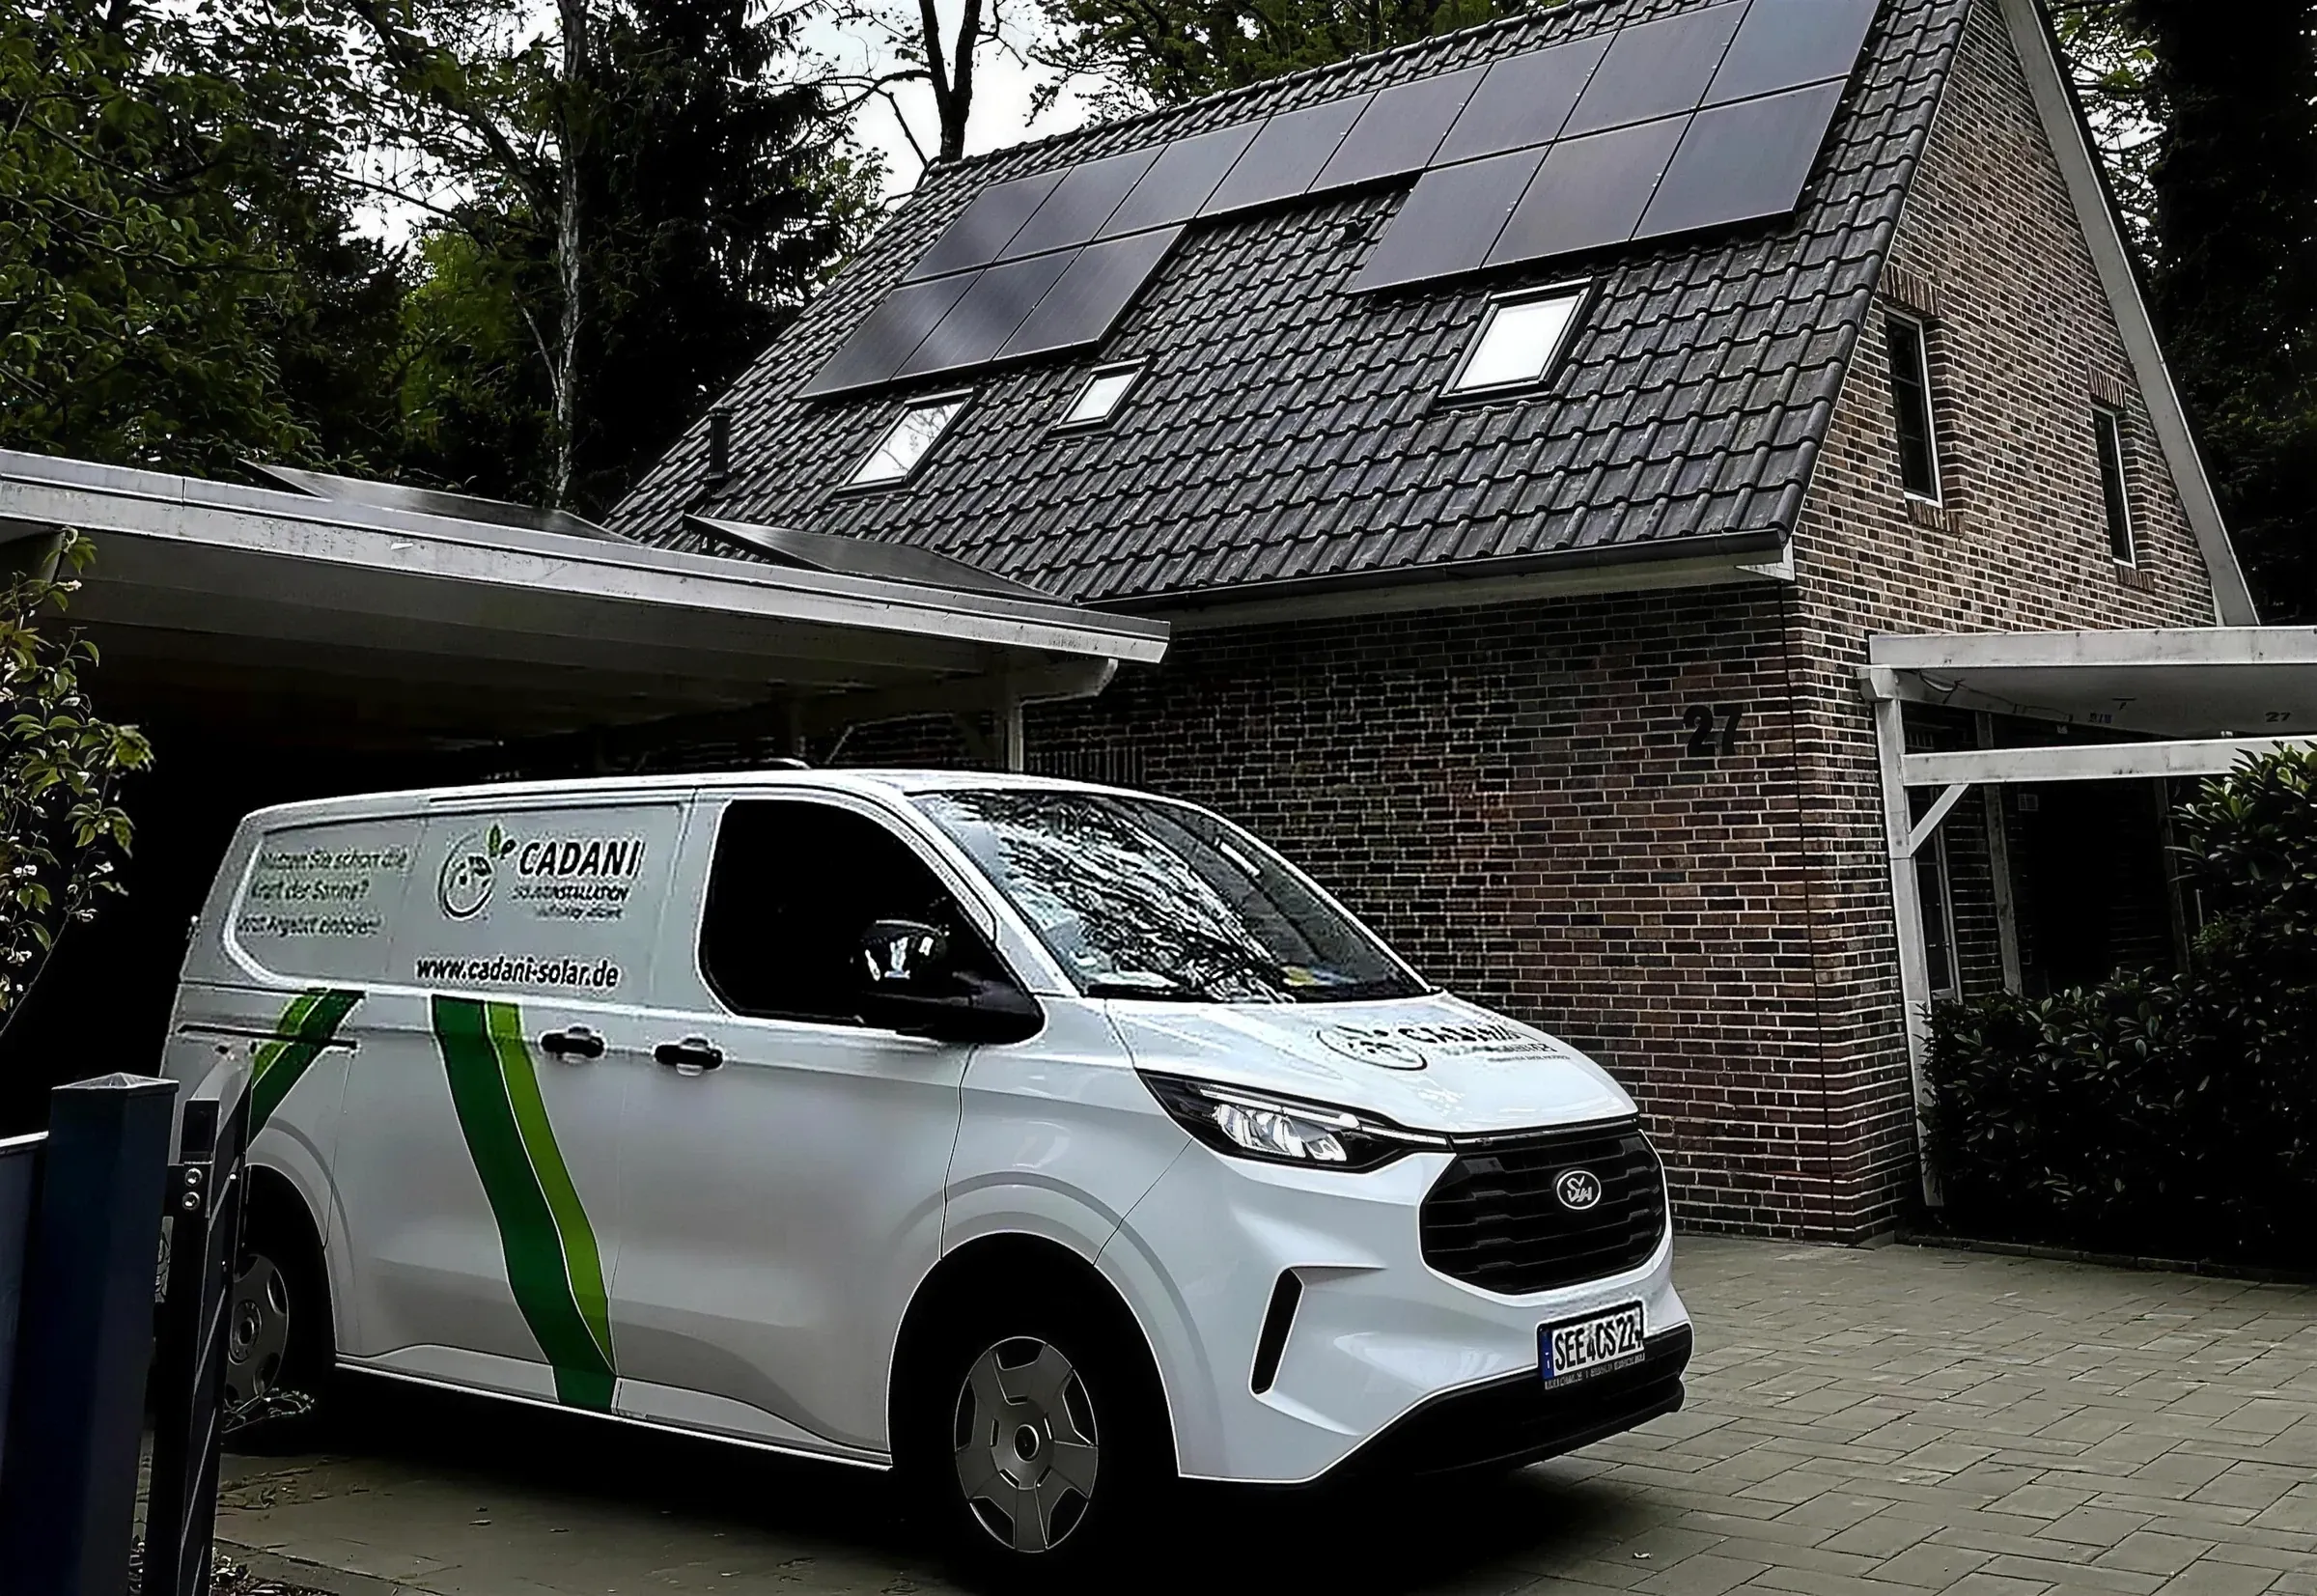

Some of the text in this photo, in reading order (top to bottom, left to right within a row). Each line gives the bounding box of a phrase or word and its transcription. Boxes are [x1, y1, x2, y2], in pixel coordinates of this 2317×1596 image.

[1684, 705, 1743, 757] 27
[2265, 711, 2291, 723] 27
[519, 840, 643, 877] CADANI
[417, 956, 619, 987] www.cadani-solar.de
